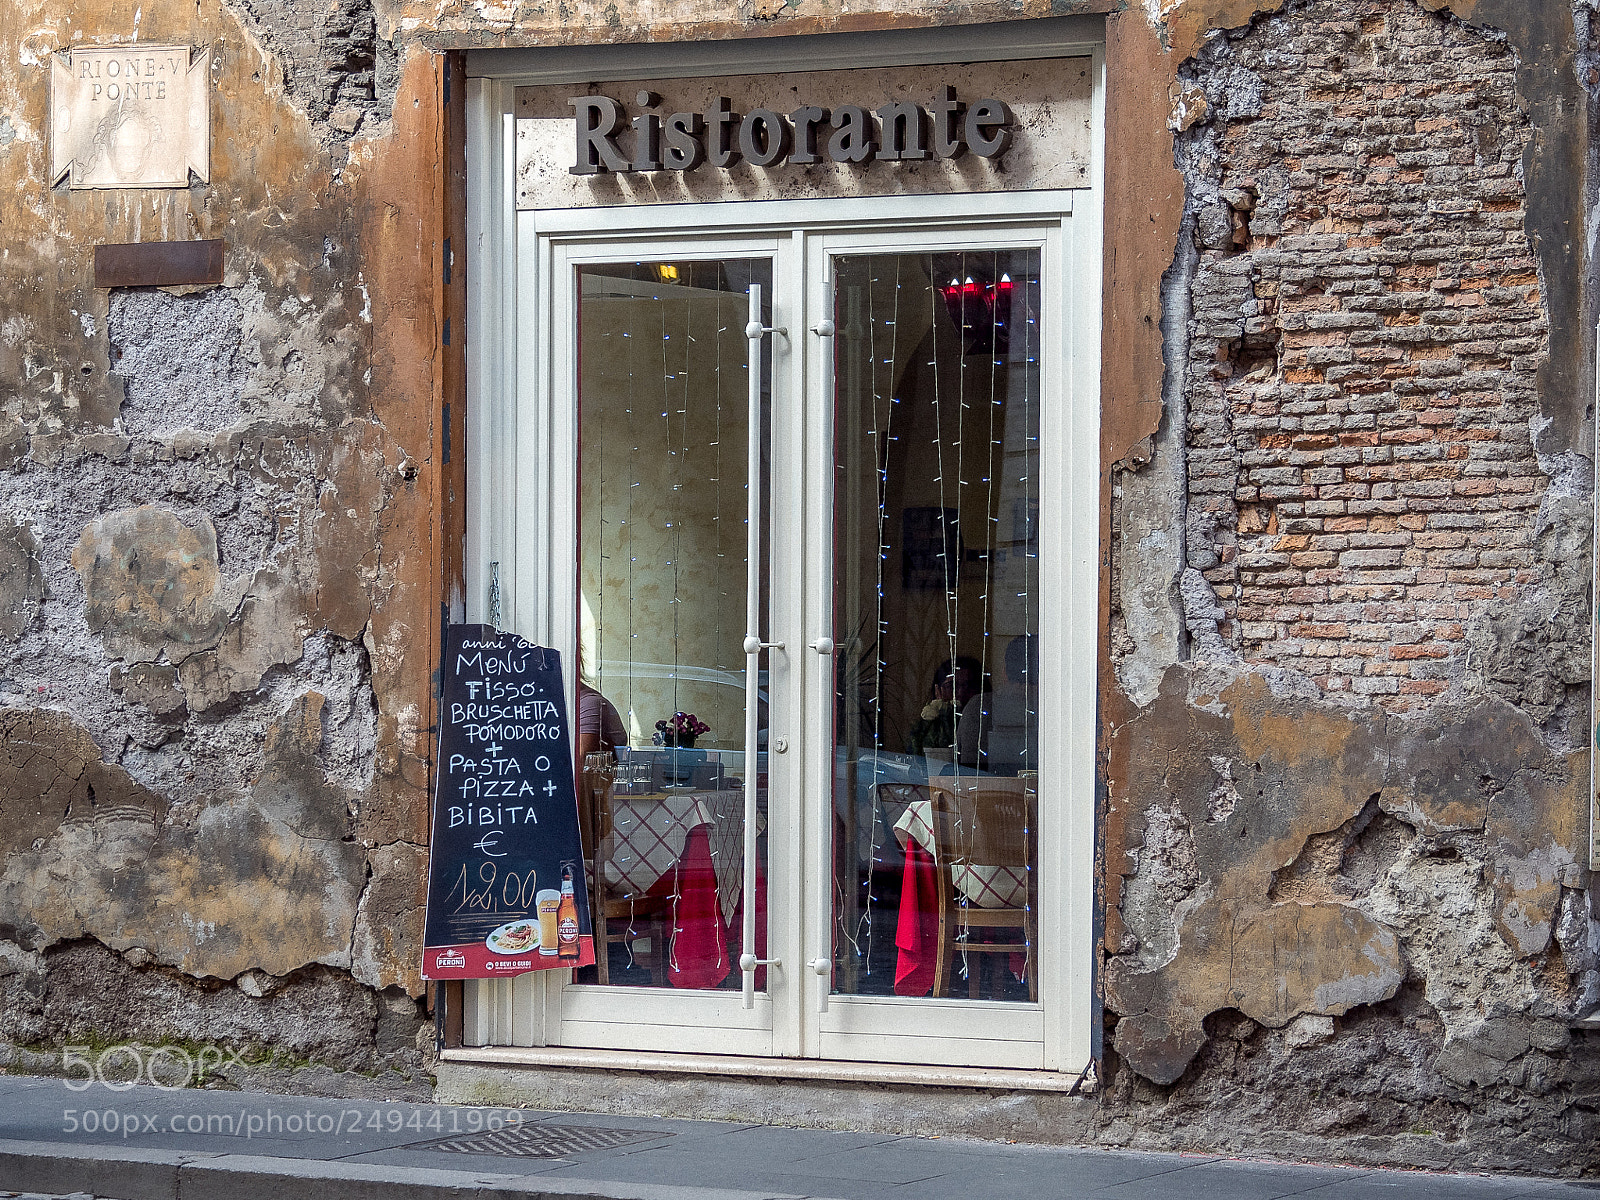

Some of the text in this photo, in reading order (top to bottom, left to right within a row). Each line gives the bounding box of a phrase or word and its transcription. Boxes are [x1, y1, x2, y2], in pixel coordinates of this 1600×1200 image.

[91, 80, 166, 101] PONTE
[568, 85, 1012, 175] Ristorante
[462, 636, 506, 649] anni
[451, 701, 559, 724] BRUSCHETTA
[463, 723, 560, 744] POMODORO
[450, 754, 550, 776] PASTA O
[473, 830, 508, 857] €
